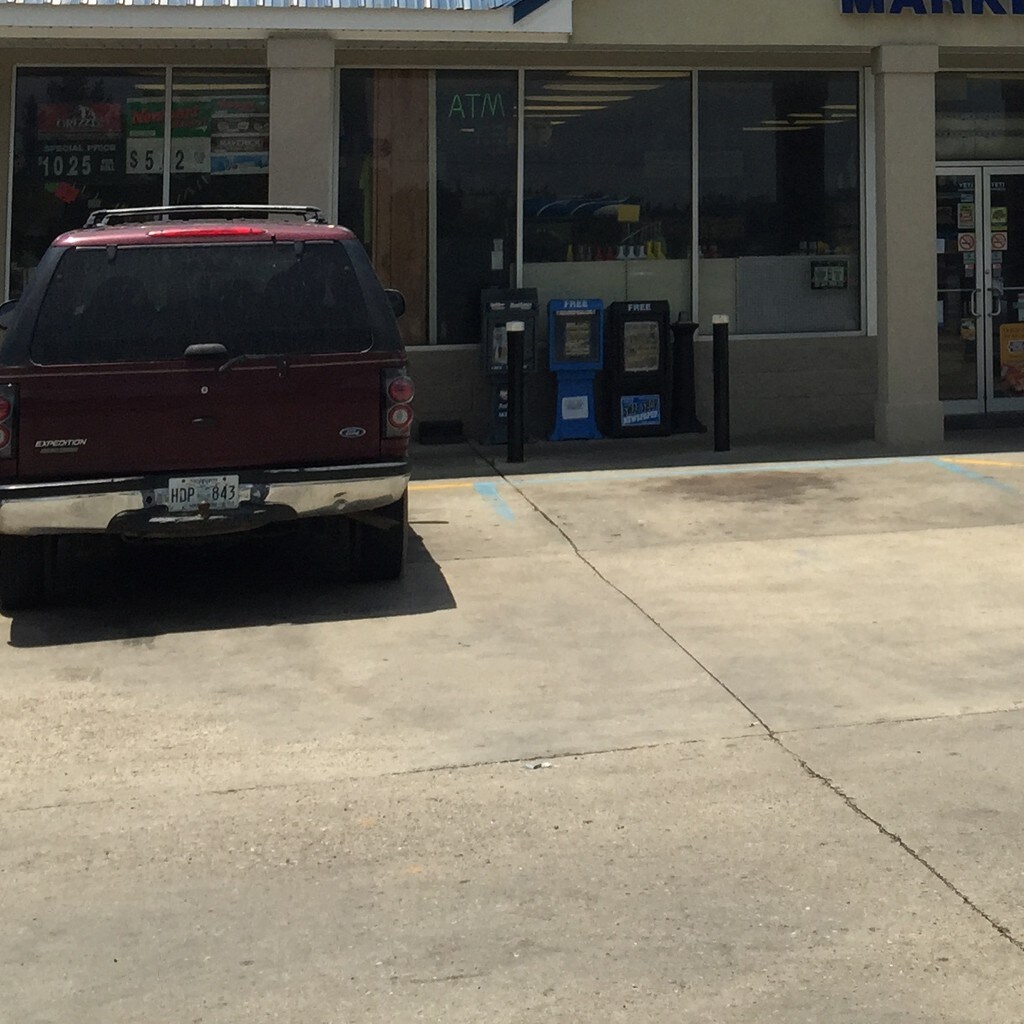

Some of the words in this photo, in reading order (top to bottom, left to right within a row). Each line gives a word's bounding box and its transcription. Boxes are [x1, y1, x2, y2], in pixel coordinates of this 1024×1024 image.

[448, 93, 506, 119] ATM
[564, 300, 588, 308] FREE
[627, 304, 652, 312] FREE
[35, 439, 87, 448] EXPEDITION
[171, 487, 195, 503] HDP
[212, 484, 236, 501] 843
